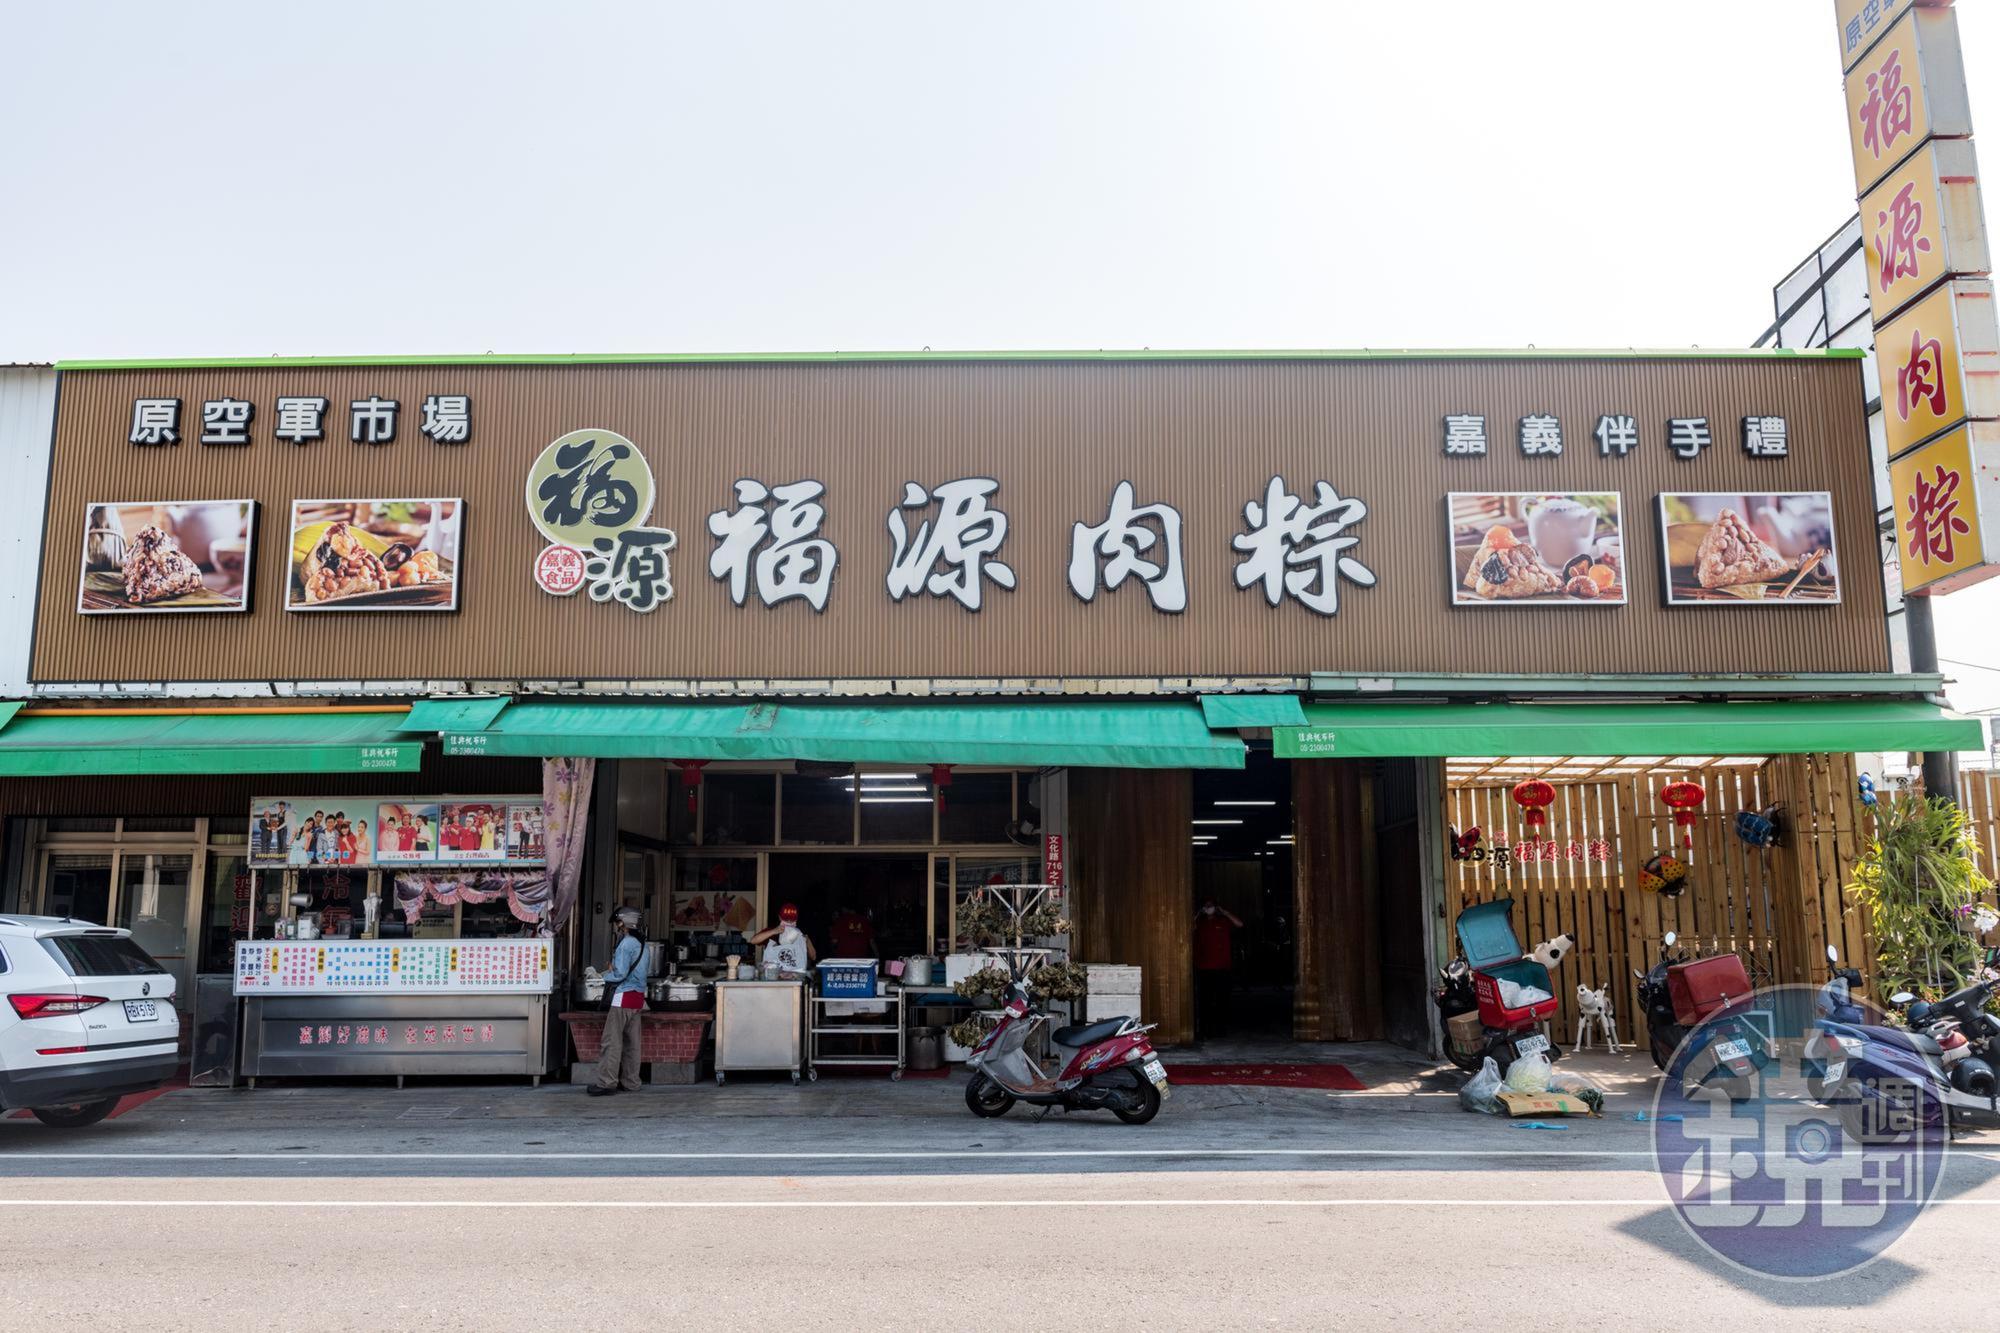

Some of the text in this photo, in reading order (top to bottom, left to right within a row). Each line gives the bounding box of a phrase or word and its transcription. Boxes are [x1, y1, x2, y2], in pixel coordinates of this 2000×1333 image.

[1859, 49, 1970, 567] 福源肉粽
[129, 394, 472, 445] 原空軍市場
[1444, 413, 1790, 459] 嘉義伴手禮
[708, 475, 1378, 616] 福源肉粽
[1513, 837, 1614, 864] 福源肉粽
